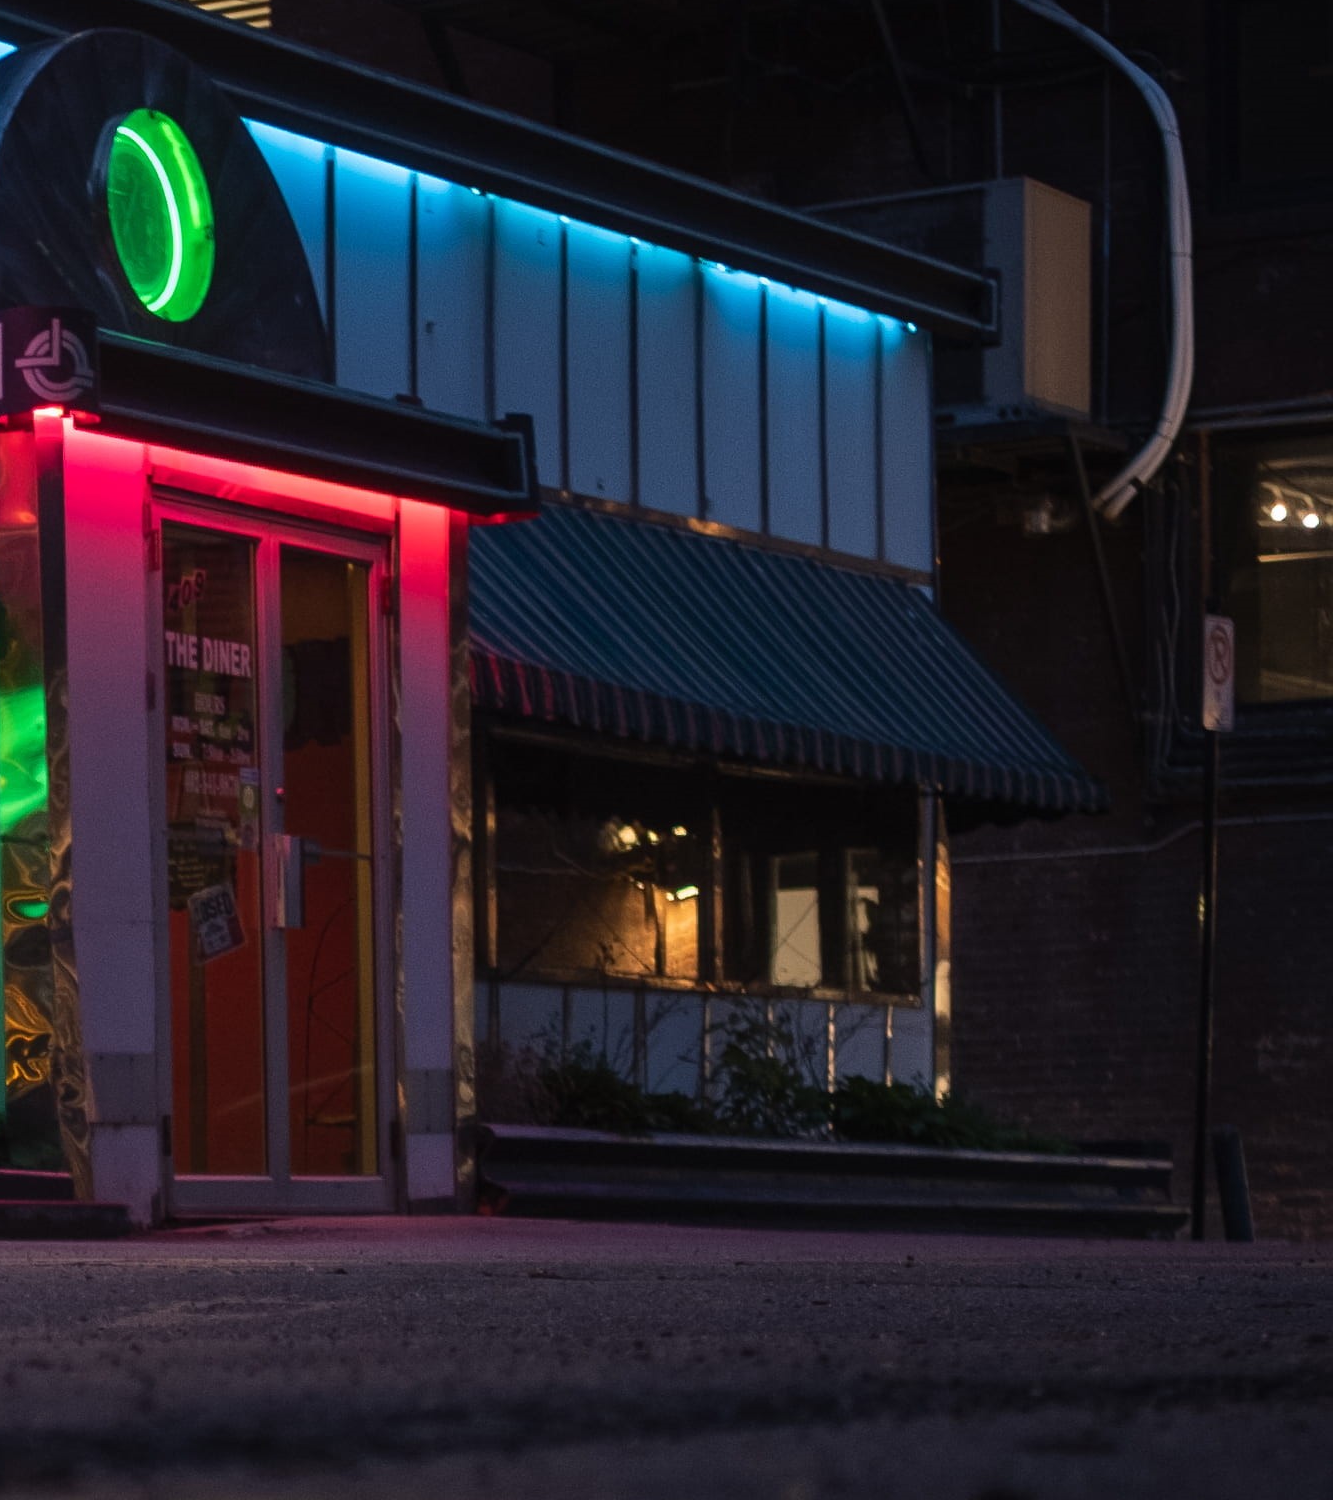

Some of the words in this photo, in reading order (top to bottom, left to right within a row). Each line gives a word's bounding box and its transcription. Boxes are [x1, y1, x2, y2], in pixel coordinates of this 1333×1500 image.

[165, 630, 198, 671] THE
[201, 636, 252, 678] DINER
[195, 891, 234, 927] OSED
